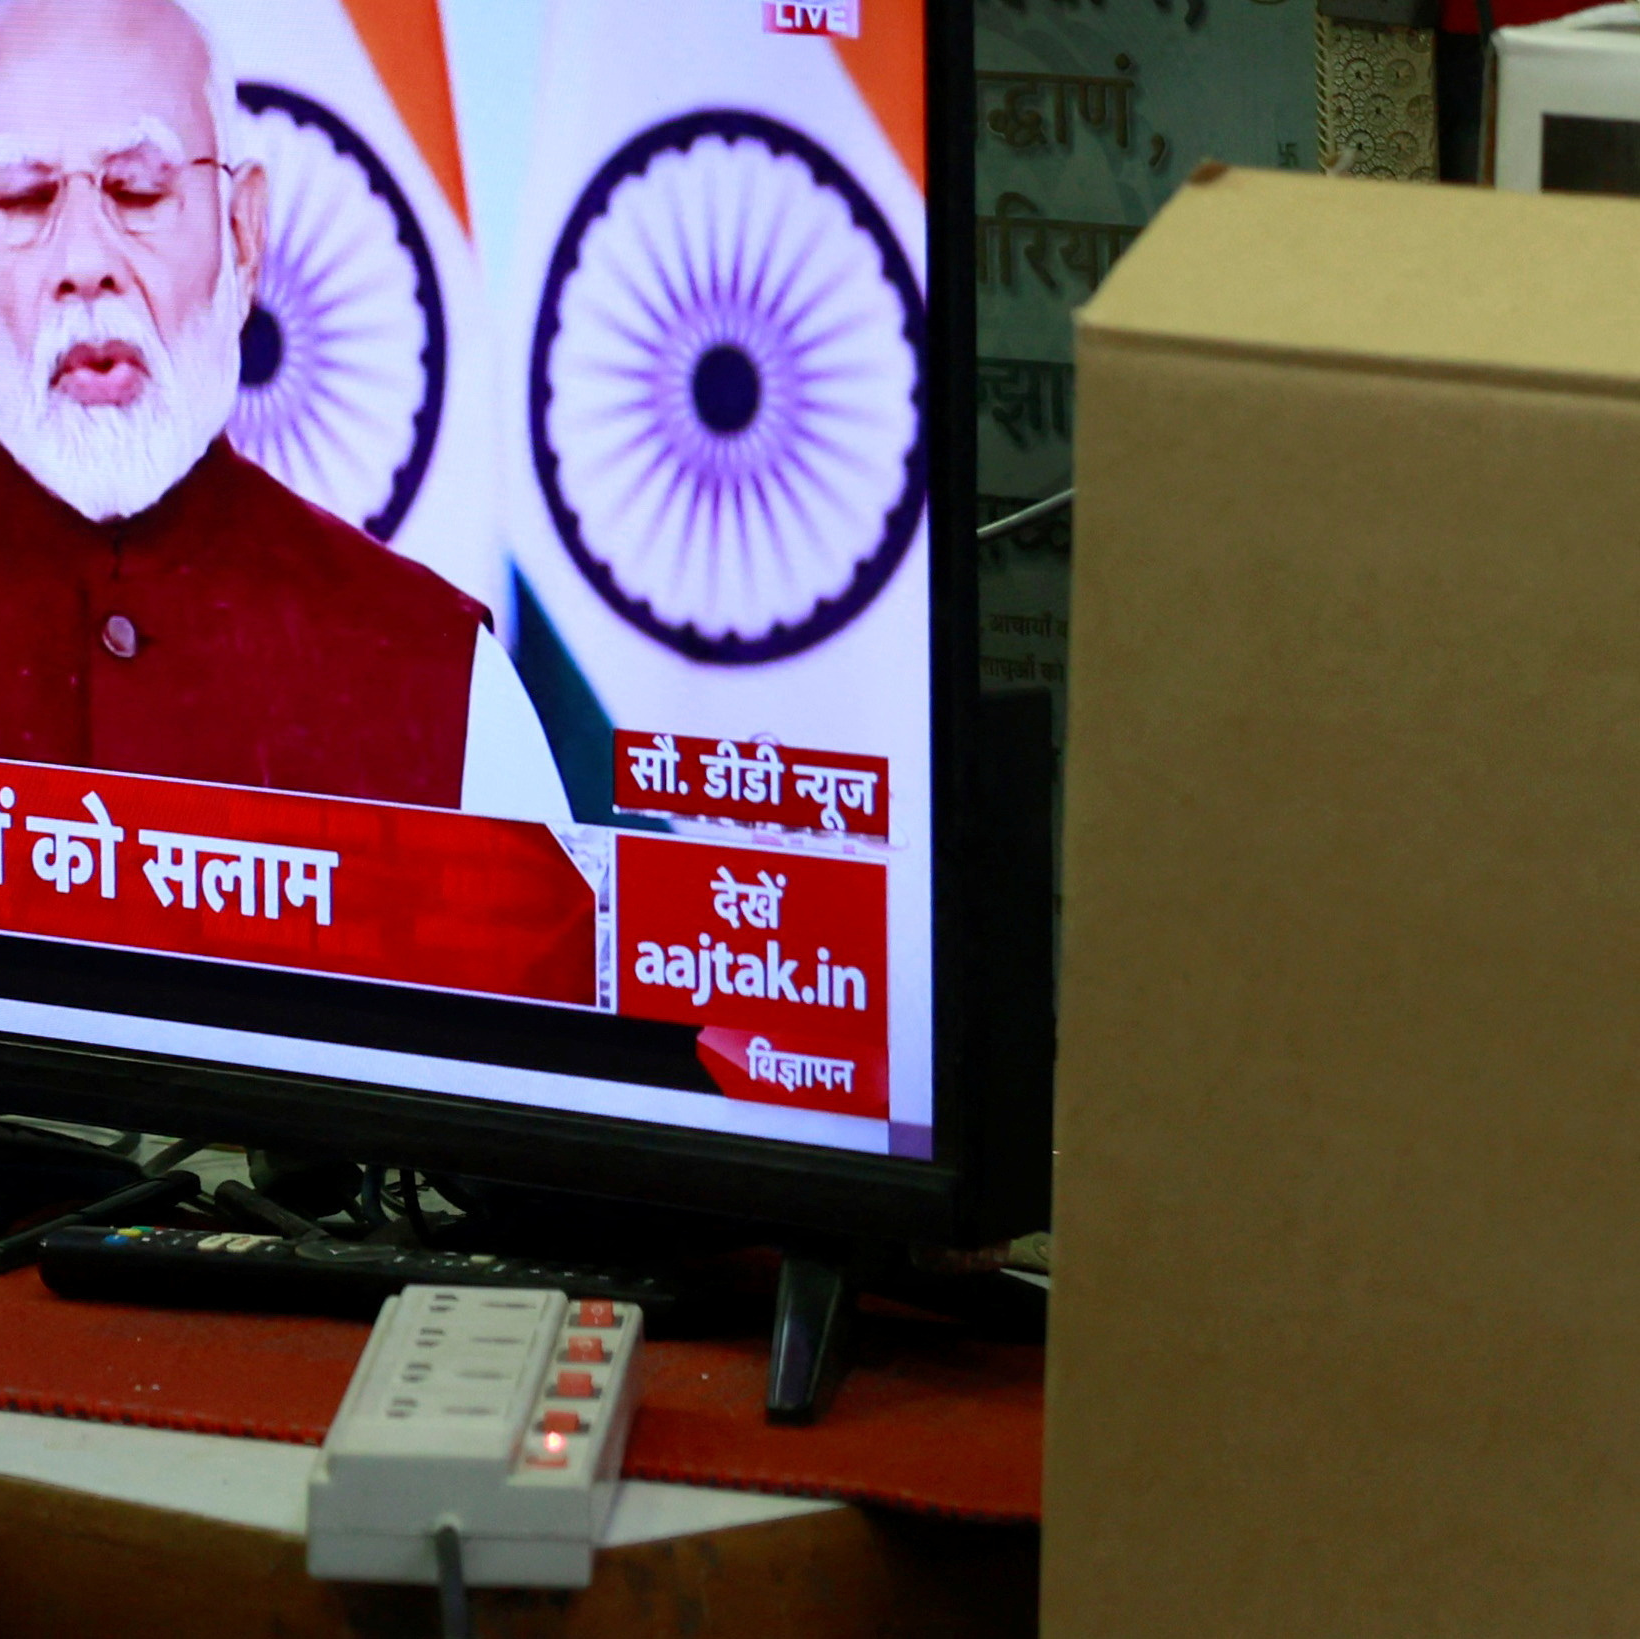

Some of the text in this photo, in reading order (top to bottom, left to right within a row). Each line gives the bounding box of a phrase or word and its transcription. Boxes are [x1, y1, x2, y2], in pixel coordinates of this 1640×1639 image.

[775, 2, 848, 32] LIVE
[977, 52, 1165, 168] द्धाणं,
[700, 740, 784, 805] डीडी
[792, 763, 878, 830] न्यूज
[25, 790, 125, 900] को
[138, 828, 340, 927] सलाम
[710, 865, 788, 930] देखें
[634, 933, 867, 1011] aajtak.in
[745, 1036, 856, 1093] विज्ञापन
